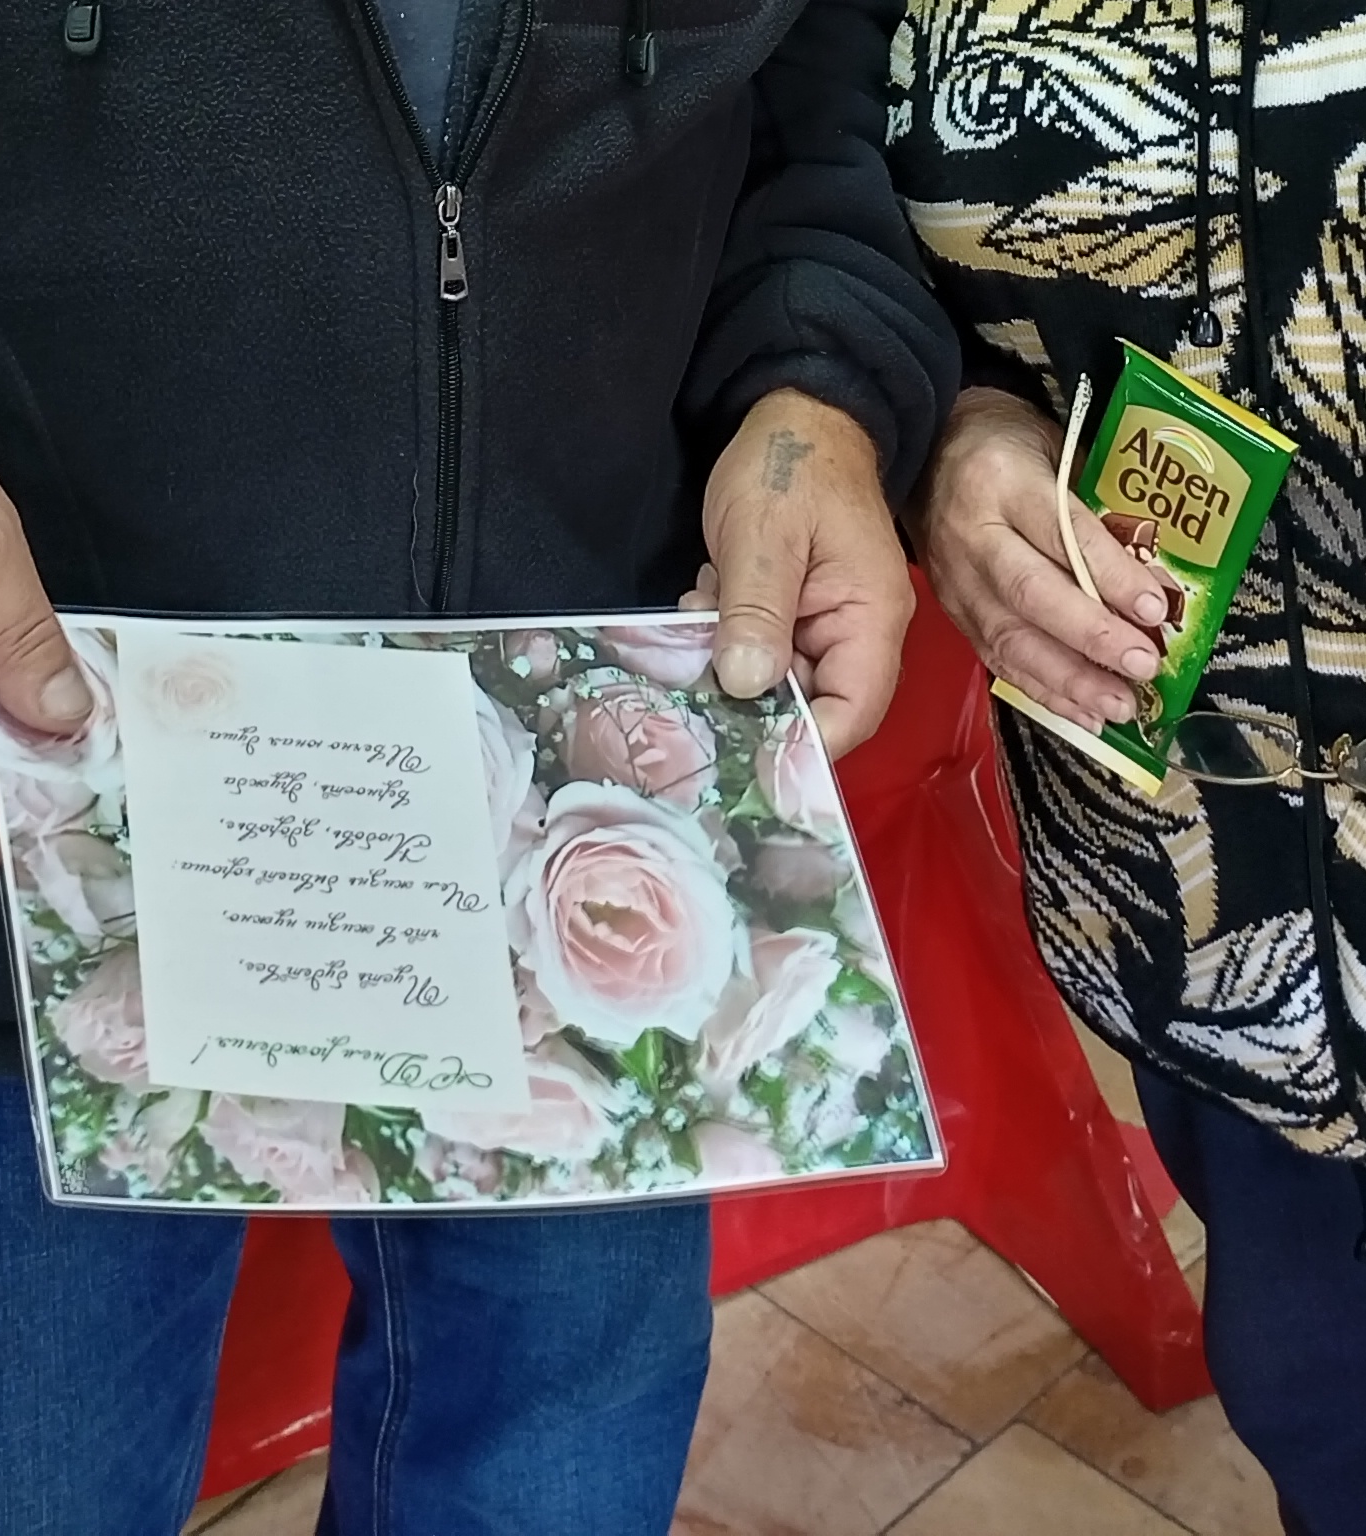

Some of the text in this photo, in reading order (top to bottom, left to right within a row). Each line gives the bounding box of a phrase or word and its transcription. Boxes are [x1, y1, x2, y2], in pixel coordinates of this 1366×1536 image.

[1118, 426, 1232, 518] Alpen
[1118, 467, 1212, 545] Gold
[268, 735, 323, 750] юная
[329, 740, 386, 763] вечно
[387, 743, 431, 774] И
[223, 771, 410, 809] верность, дружба
[219, 815, 432, 863] Любовь, здоровье,
[171, 856, 489, 913] Чем жизнь бывает хороша:
[222, 909, 440, 947] что в жизни нужно,
[238, 958, 449, 1007] Пусть будет все,
[190, 1034, 492, 1091] С Днем рождения!
